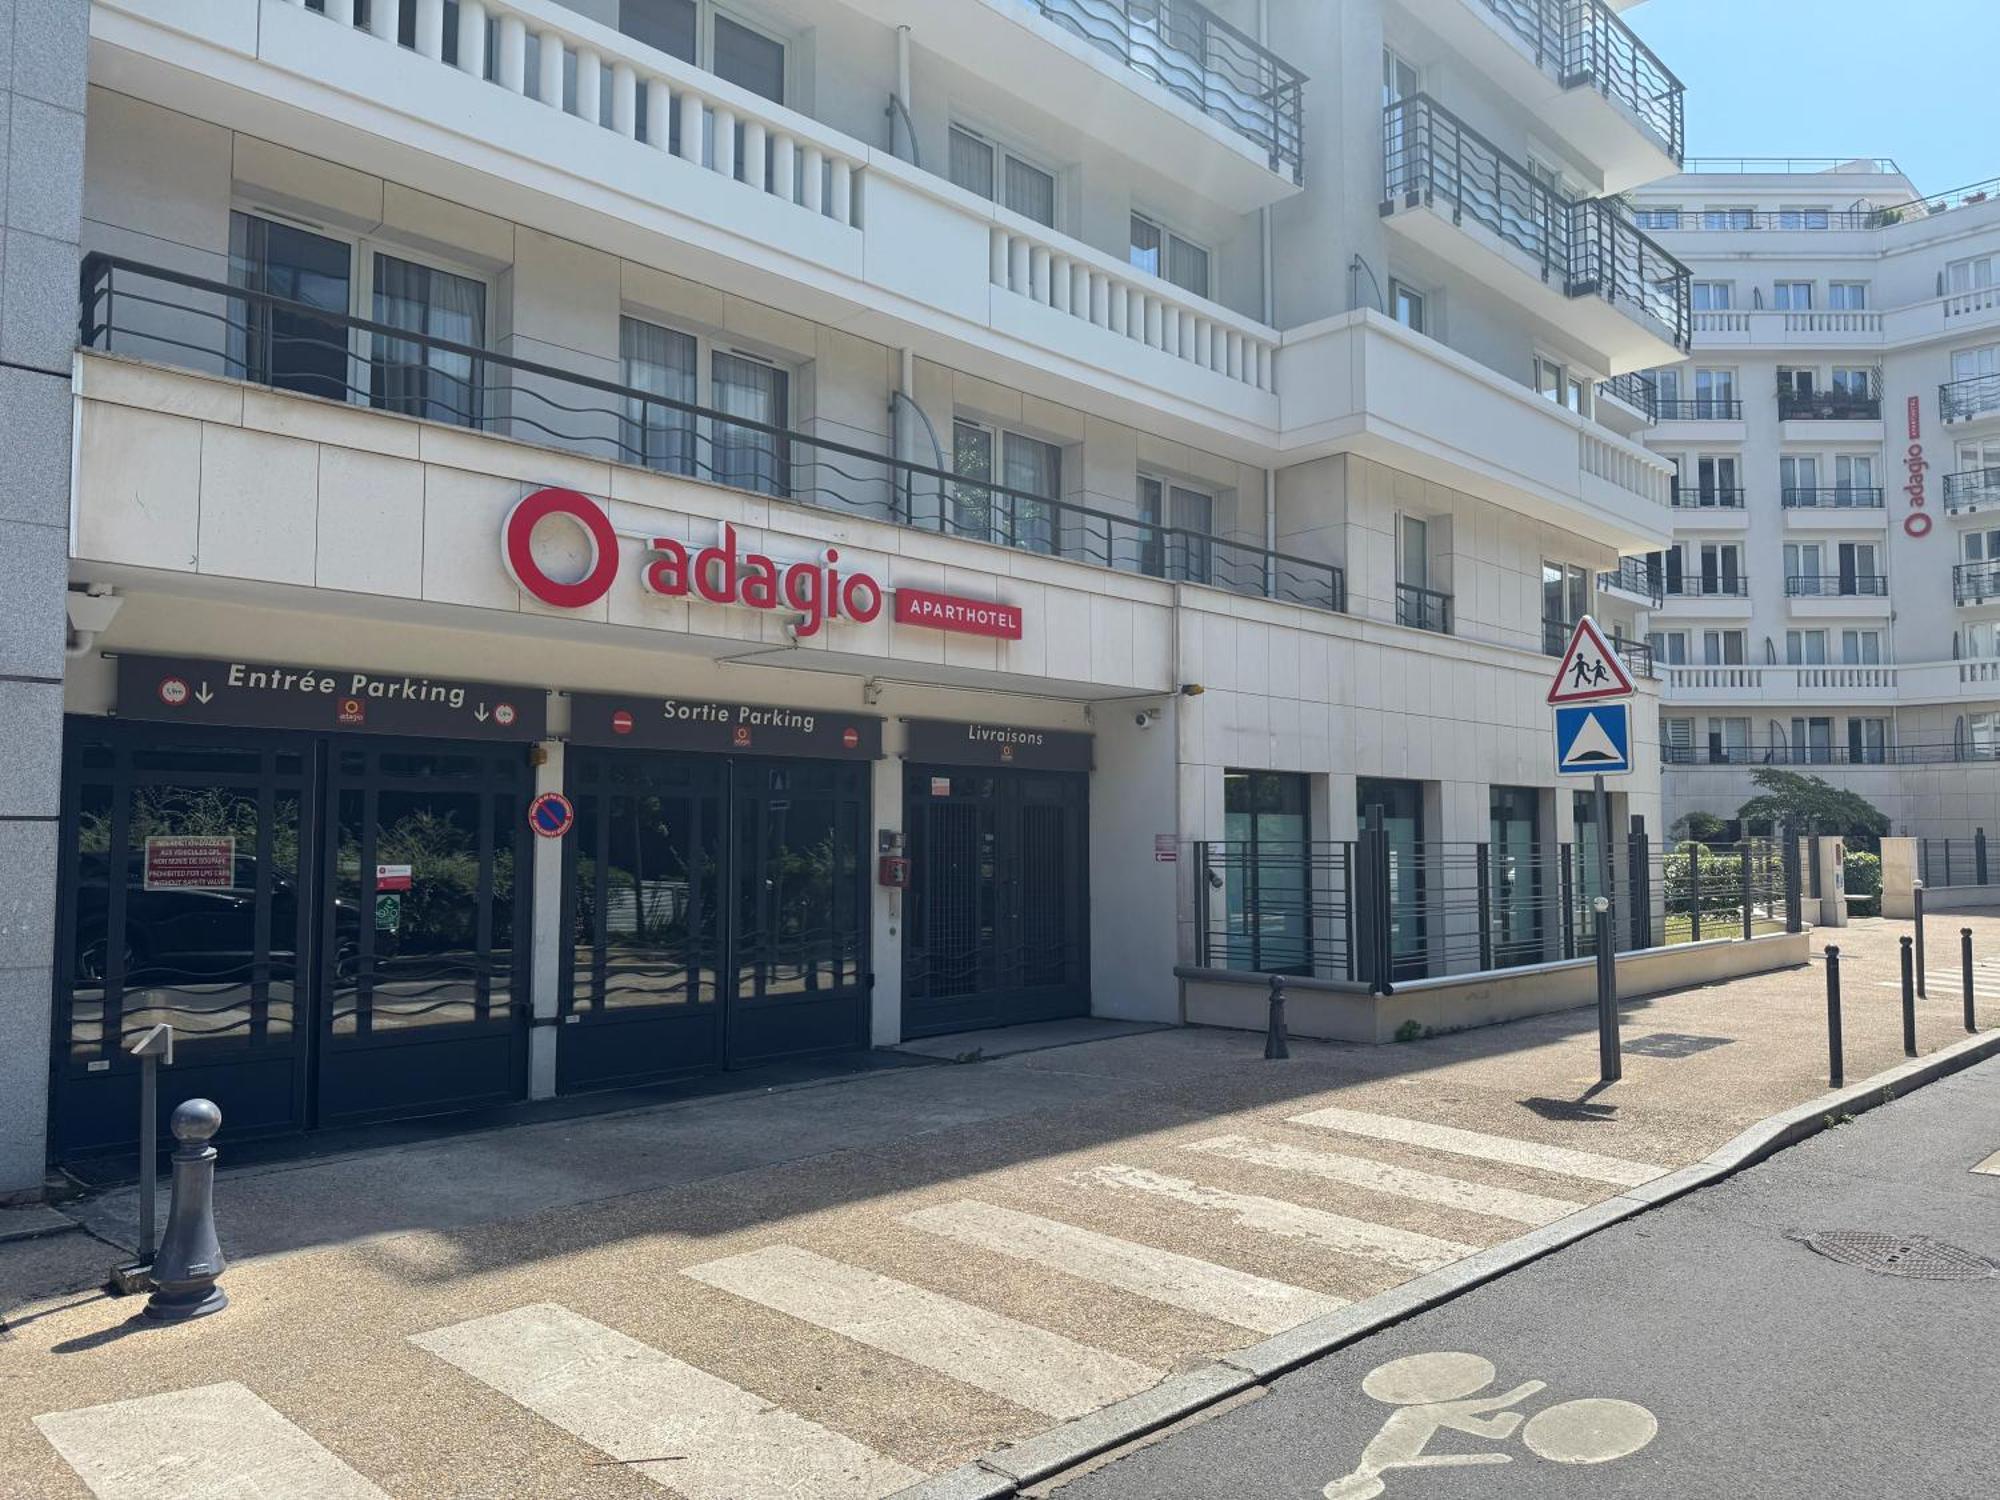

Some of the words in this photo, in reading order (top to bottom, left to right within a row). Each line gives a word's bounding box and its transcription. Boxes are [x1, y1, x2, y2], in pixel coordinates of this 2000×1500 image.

[1904, 444, 1929, 508] adagio
[643, 520, 882, 638] adagio
[909, 599, 1017, 629] APARTHOTEL
[228, 663, 336, 693] Entrée
[350, 674, 465, 708] Parking
[664, 700, 729, 722] Sortie
[738, 706, 815, 733] Parking
[968, 724, 1044, 745] Livraisons
